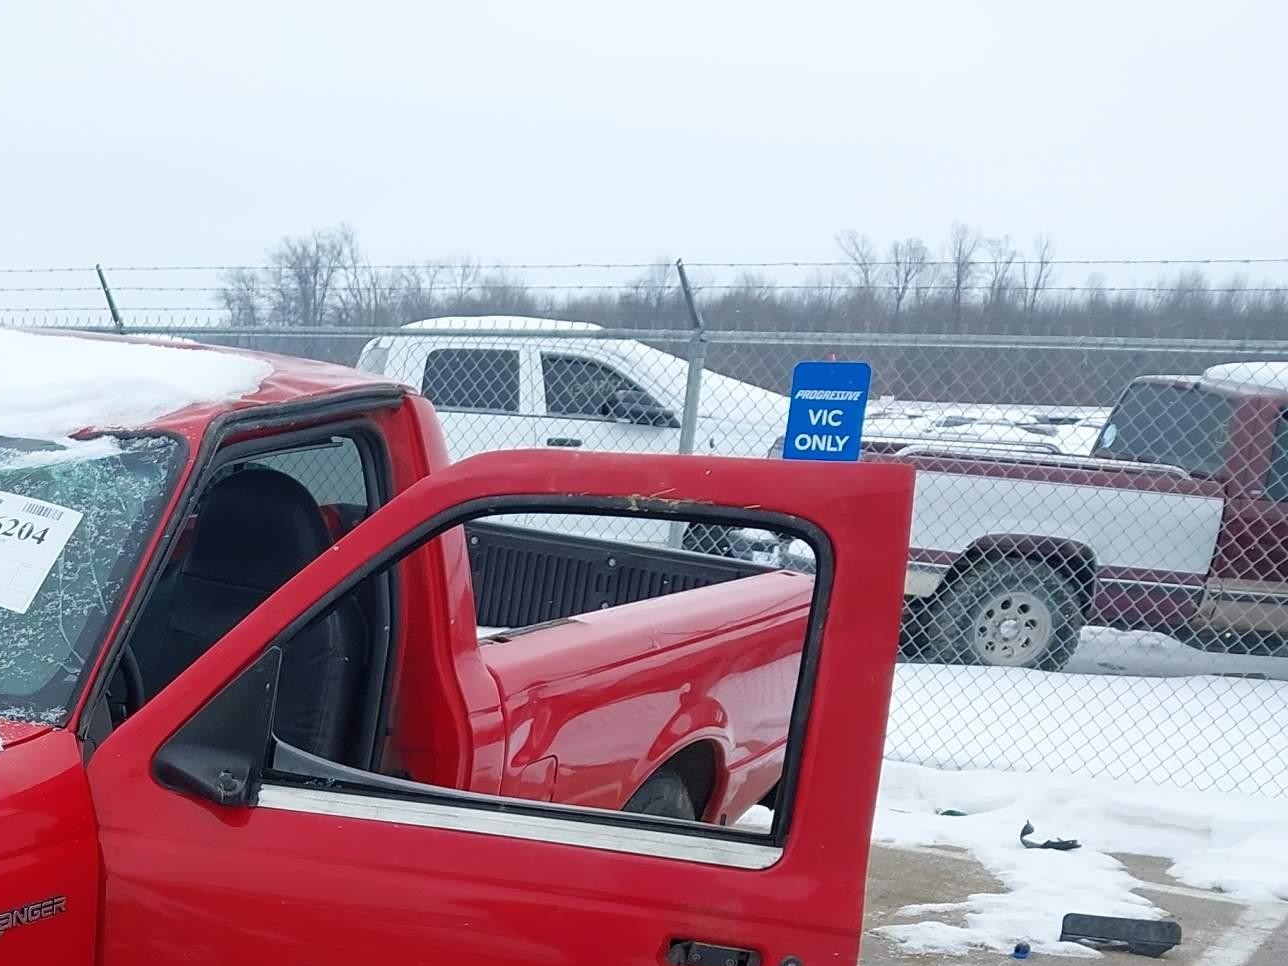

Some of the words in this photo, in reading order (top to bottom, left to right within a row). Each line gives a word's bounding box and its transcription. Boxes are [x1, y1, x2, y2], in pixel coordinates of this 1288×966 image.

[795, 389, 863, 401] PROGRESSIVE
[808, 409, 843, 427] VIC
[794, 433, 850, 452] ONLY
